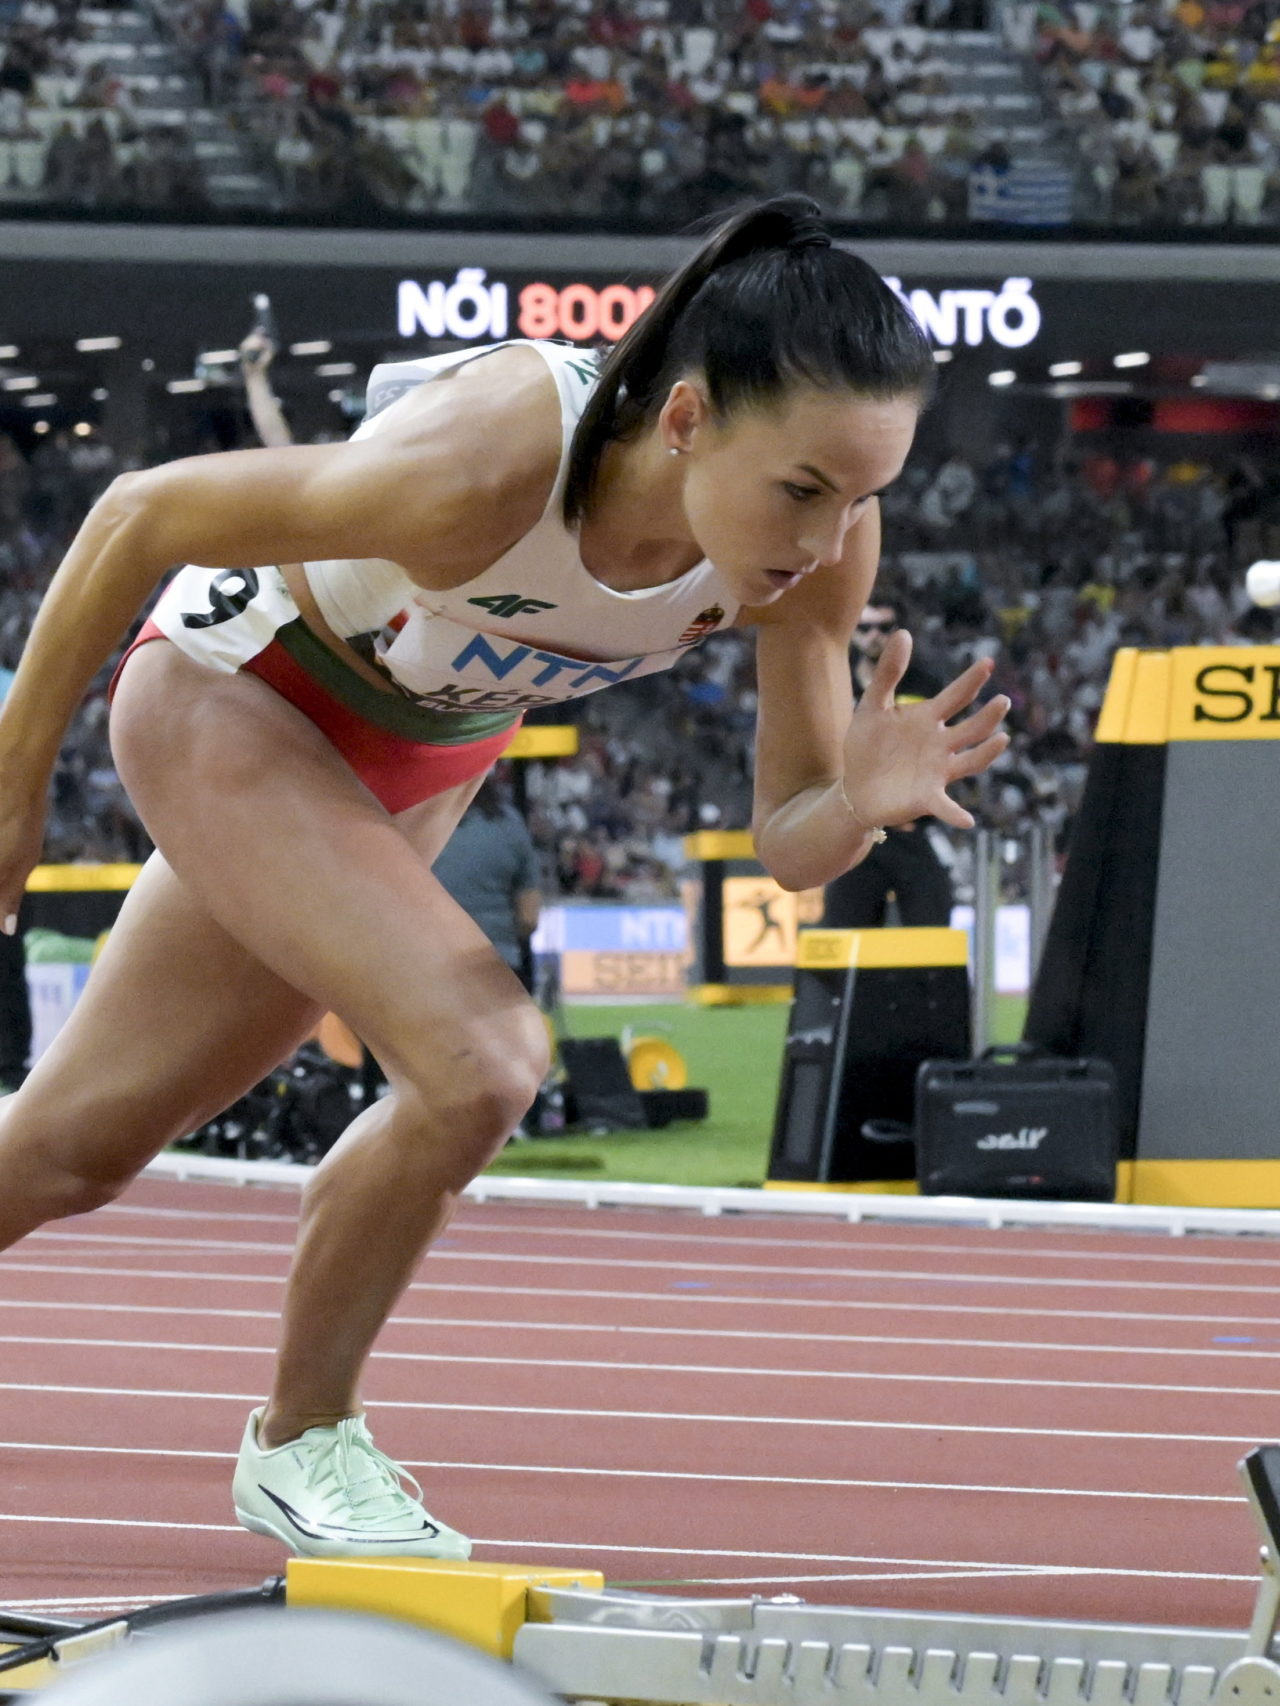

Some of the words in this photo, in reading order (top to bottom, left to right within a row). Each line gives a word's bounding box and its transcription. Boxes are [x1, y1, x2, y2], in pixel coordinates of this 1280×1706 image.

[882, 276, 1041, 347] NTŐ
[180, 568, 260, 629] 9
[451, 633, 645, 688] NTN
